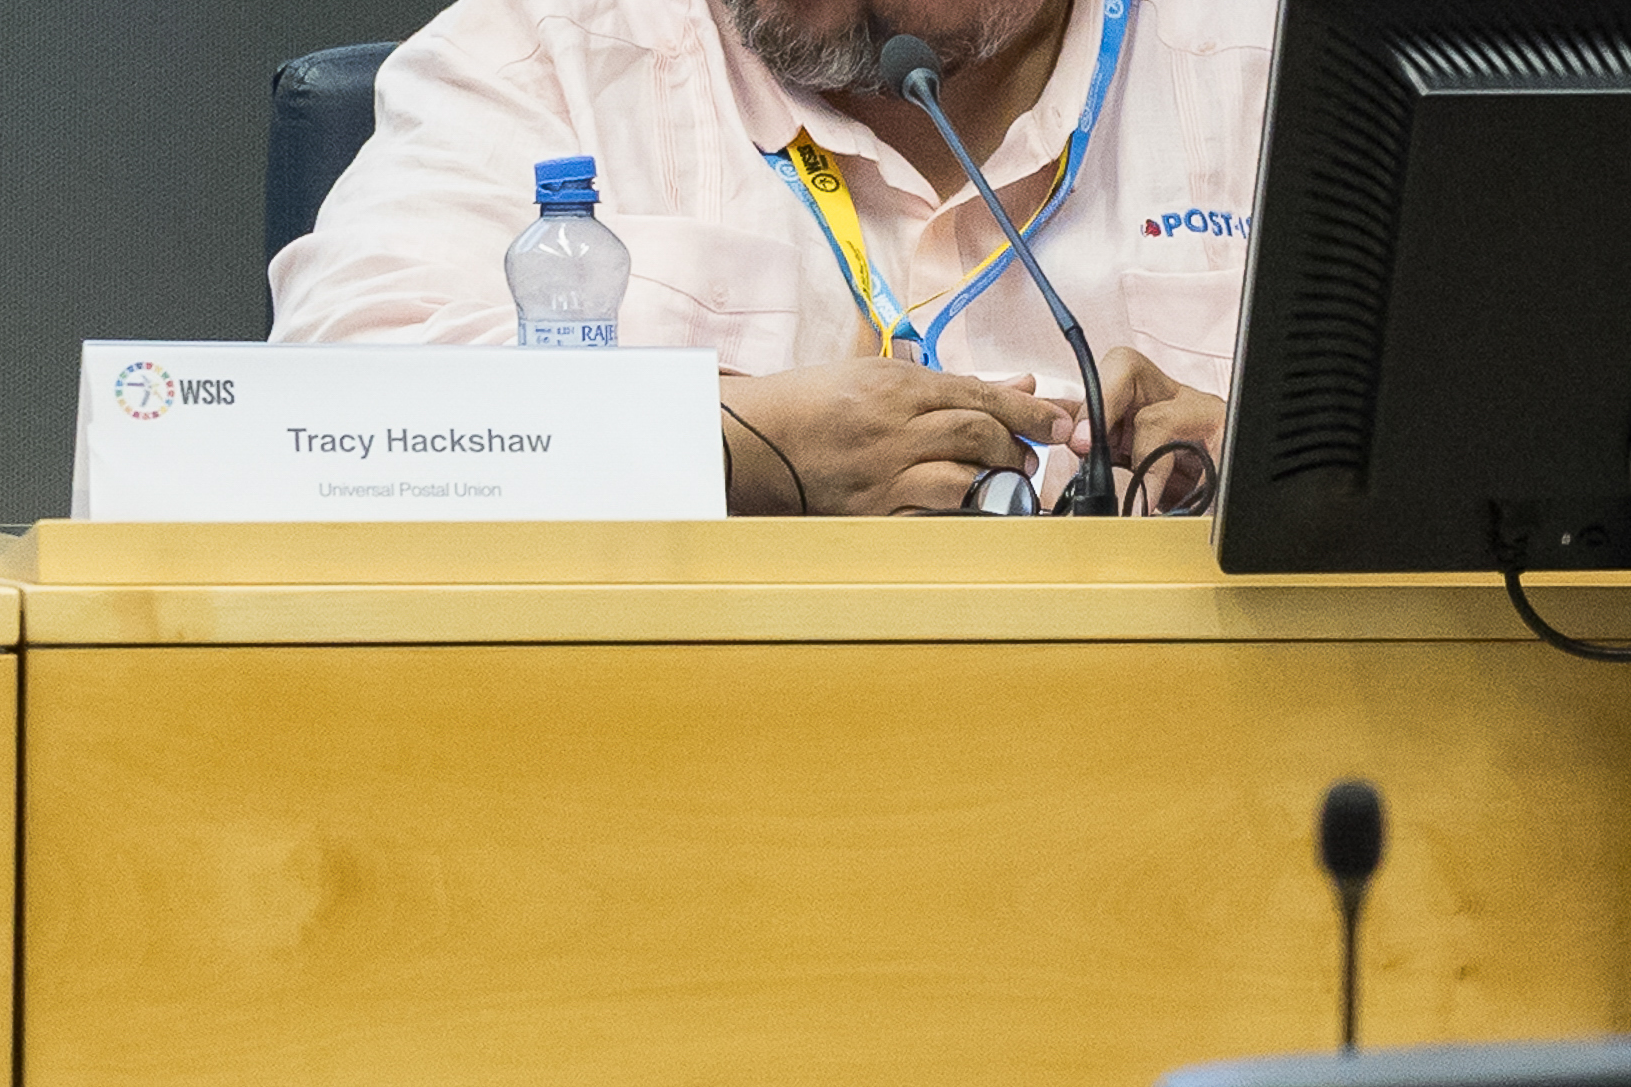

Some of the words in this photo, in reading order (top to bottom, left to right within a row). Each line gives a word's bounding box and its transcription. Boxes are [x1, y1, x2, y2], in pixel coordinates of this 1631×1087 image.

[179, 379, 235, 405] WSIS
[287, 428, 374, 460] Tracy
[387, 428, 552, 453] Hackshaw
[319, 482, 395, 498] Universal
[400, 482, 450, 498] Postal
[455, 482, 502, 498] Union
